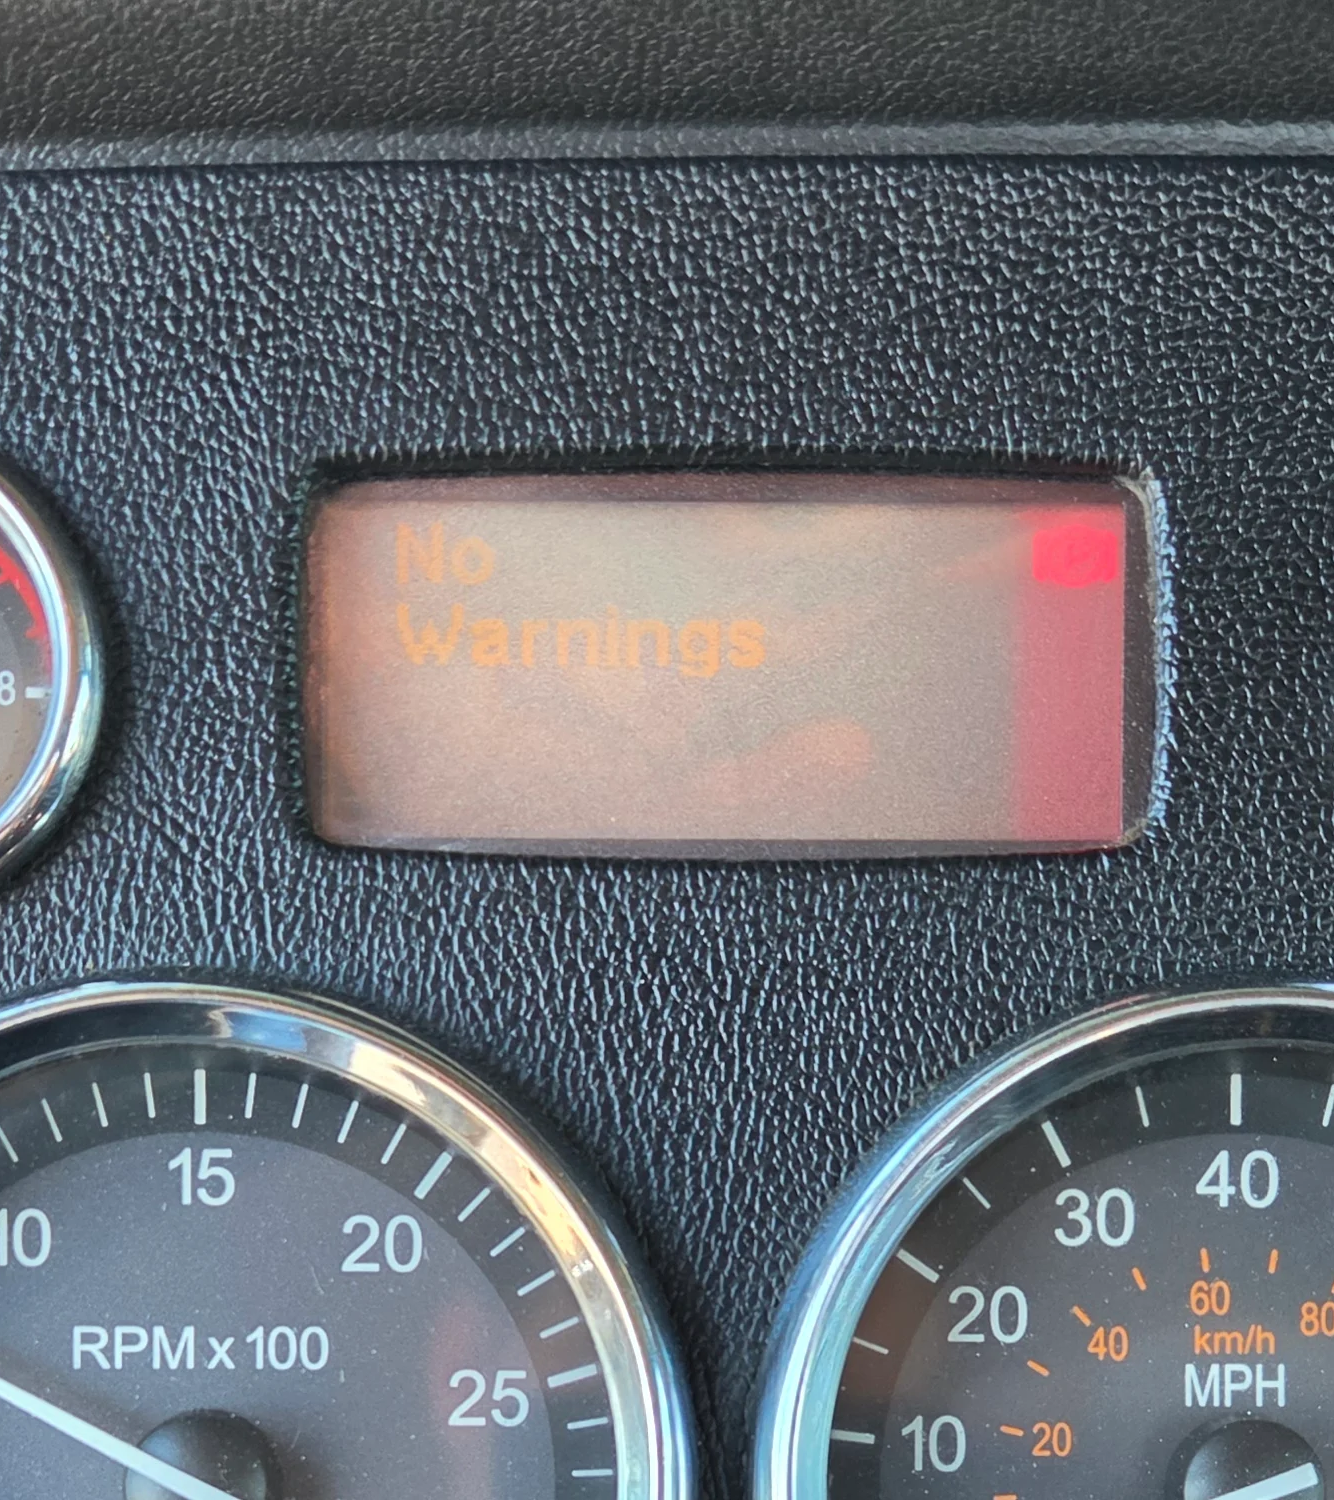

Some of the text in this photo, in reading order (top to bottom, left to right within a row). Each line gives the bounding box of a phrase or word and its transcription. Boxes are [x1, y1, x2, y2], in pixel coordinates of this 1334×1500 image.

[396, 522, 495, 585] No
[396, 603, 767, 678] Warnings
[168, 1148, 236, 1205] 15
[1196, 1149, 1280, 1209] 40
[341, 1215, 423, 1274] 20
[1054, 1187, 1135, 1247] 30
[947, 1284, 1028, 1344] 20
[1190, 1280, 1230, 1316] 60
[71, 1325, 330, 1371] RPM x 100
[1087, 1326, 1128, 1361] 40
[1193, 1325, 1275, 1355] km/h
[447, 1370, 529, 1427] 25
[1185, 1363, 1286, 1408] MPH
[901, 1414, 967, 1473] 10
[1032, 1422, 1072, 1457] 20
